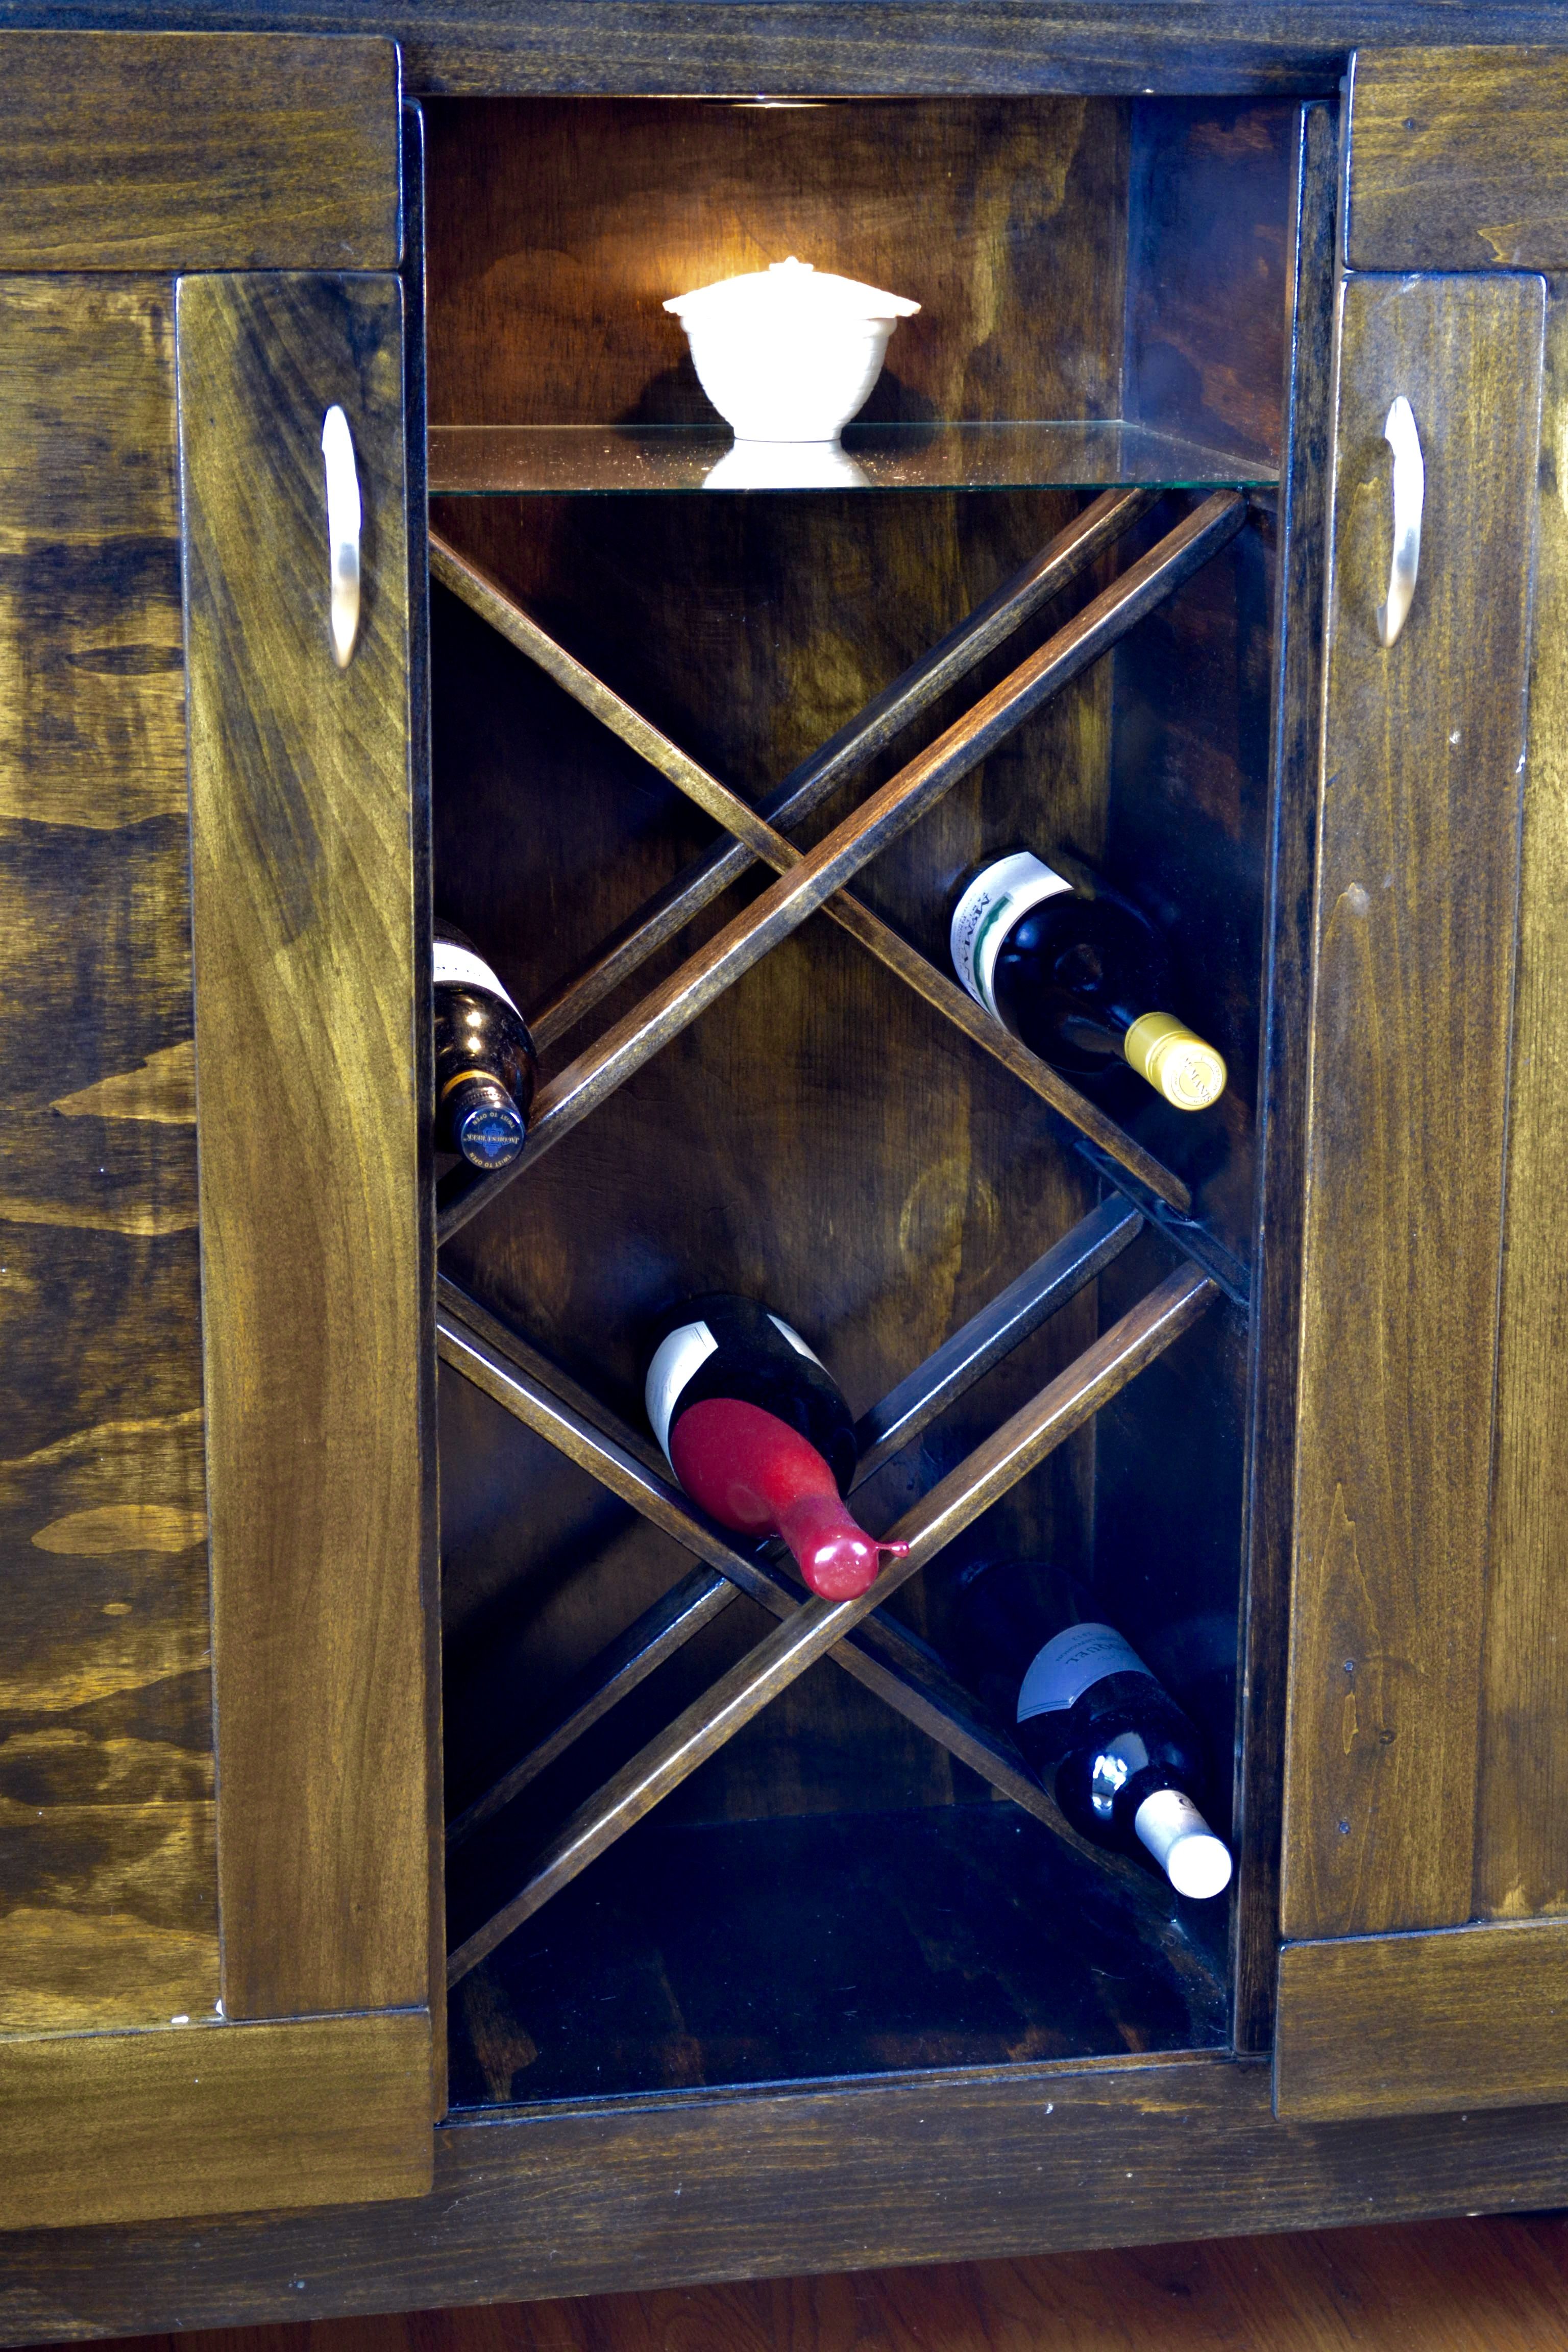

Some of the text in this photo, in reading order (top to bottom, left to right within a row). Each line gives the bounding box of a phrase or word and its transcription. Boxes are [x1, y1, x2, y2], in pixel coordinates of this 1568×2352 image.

[472, 1113, 487, 1125] OPEN
[500, 1114, 514, 1129] TWIST
[469, 1152, 483, 1166] OPEN
[495, 1154, 512, 1168] TWIST
